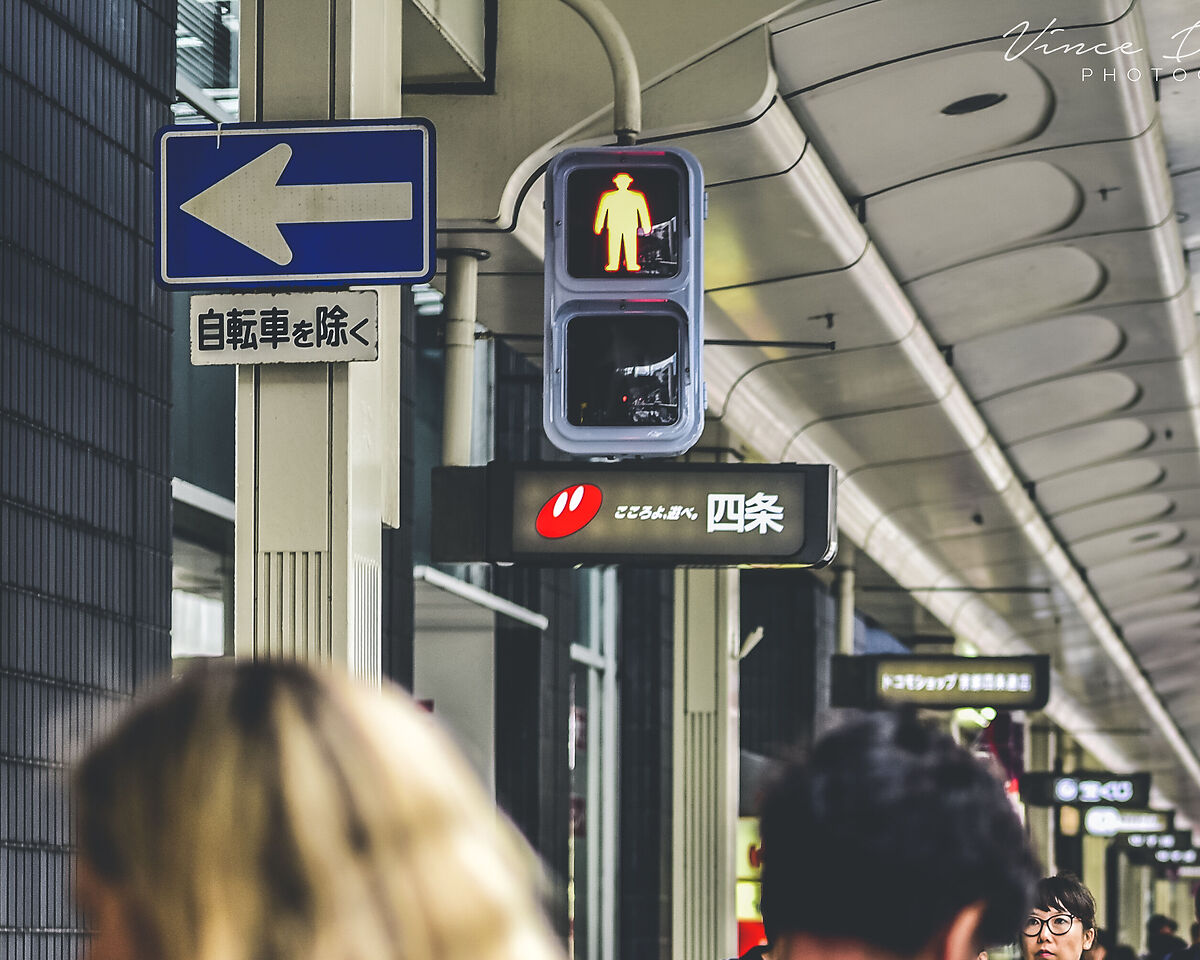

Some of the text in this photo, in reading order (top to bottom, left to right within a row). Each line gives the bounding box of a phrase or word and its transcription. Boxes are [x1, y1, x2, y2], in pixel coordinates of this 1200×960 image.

[198, 305, 370, 351] 自転車を除く
[706, 491, 785, 535] 四条
